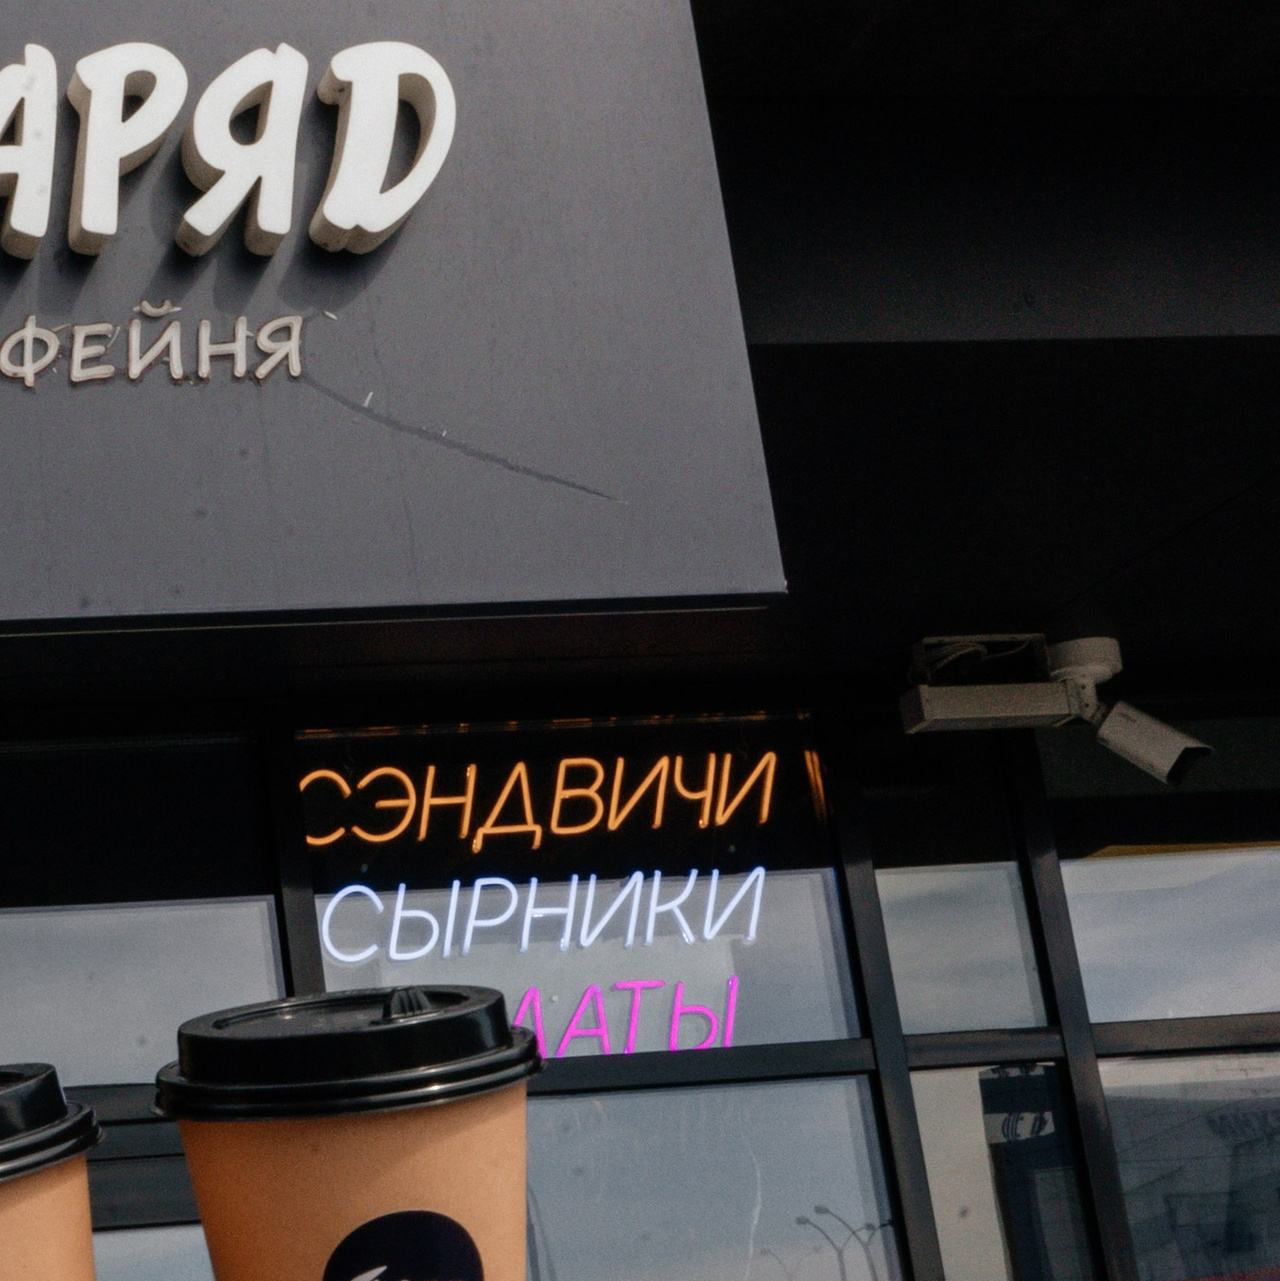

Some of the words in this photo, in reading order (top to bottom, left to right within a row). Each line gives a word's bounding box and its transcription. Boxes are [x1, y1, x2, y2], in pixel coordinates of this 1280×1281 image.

[299, 751, 778, 854] СЭНДВИЧИ
[321, 866, 767, 963] СЫРНИКИ
[513, 973, 739, 1060] ЛАТЫ
